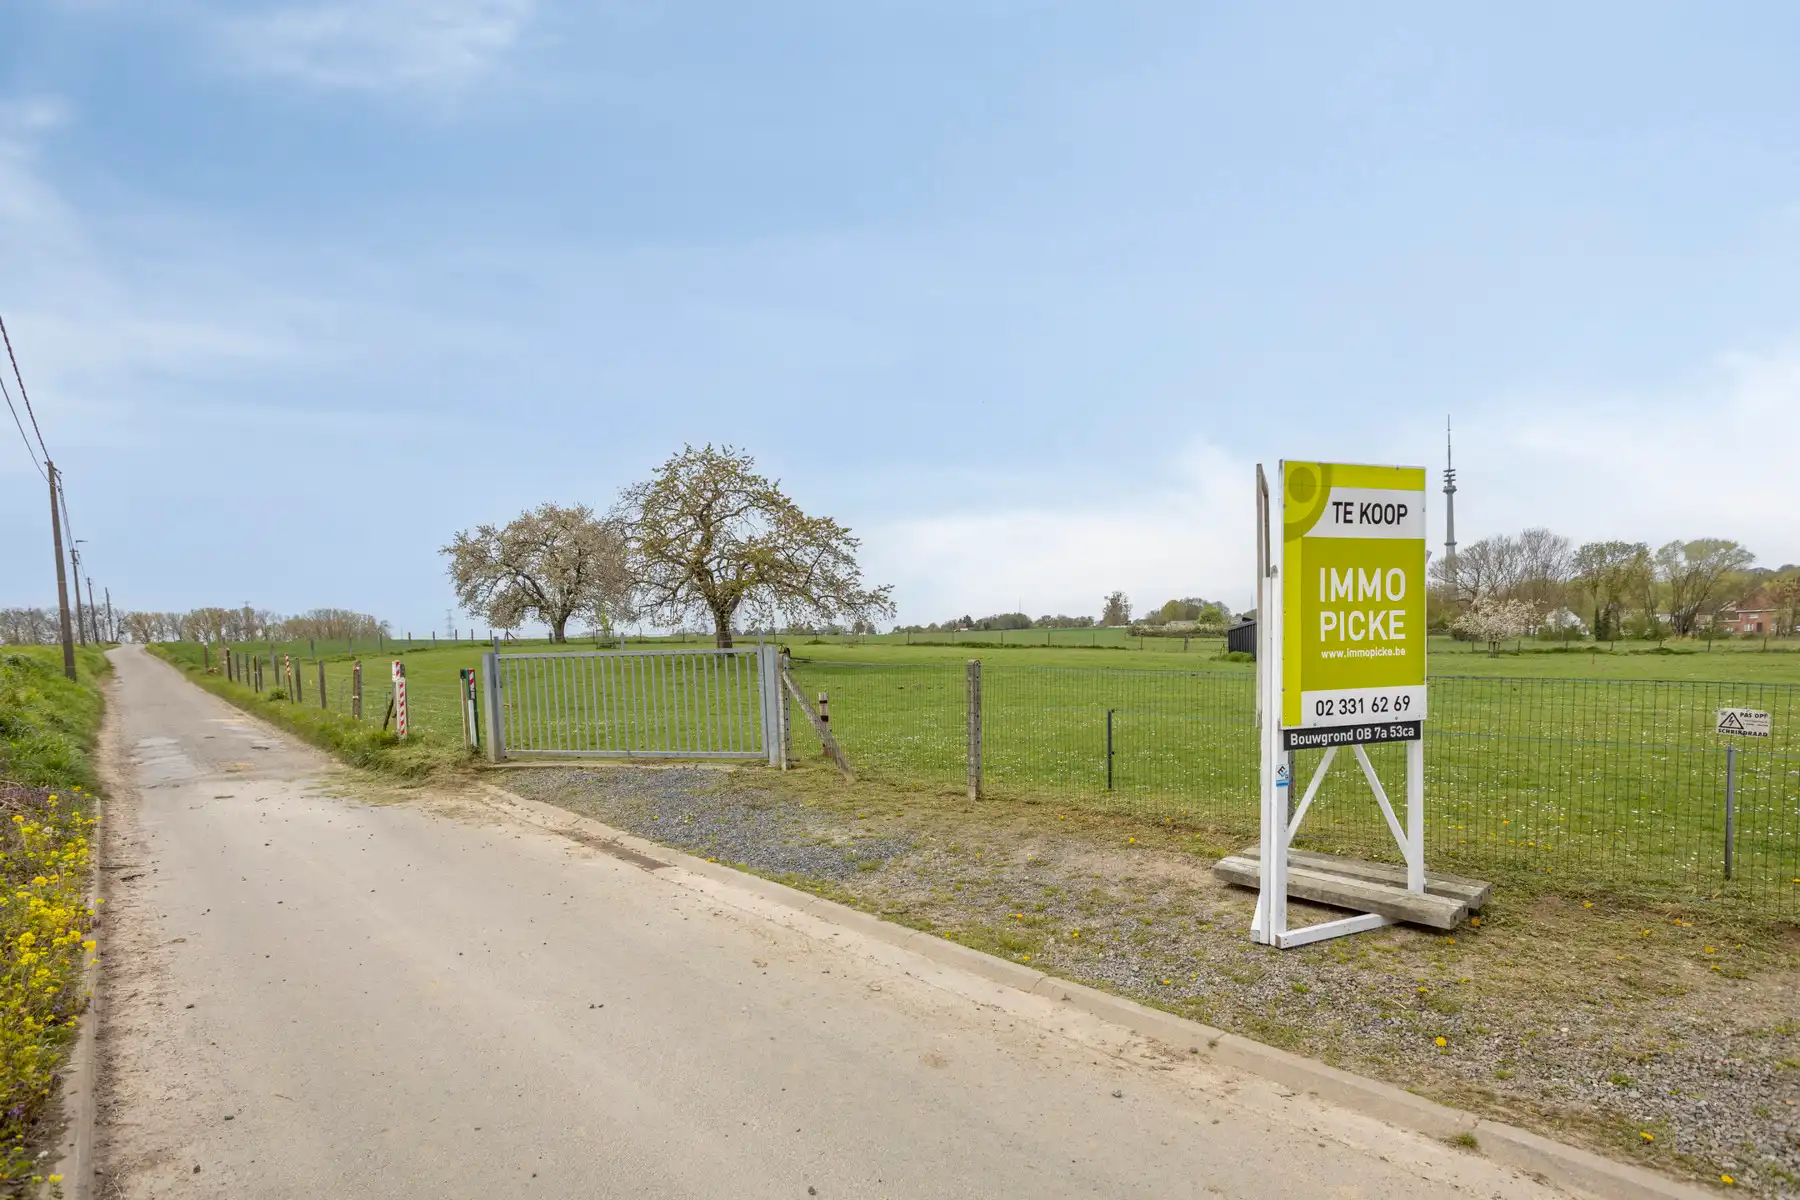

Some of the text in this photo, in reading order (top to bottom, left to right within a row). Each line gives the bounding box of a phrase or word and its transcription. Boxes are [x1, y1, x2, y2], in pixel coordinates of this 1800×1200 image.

[1332, 501, 1408, 525] TE KOOP
[1319, 567, 1406, 602] IMMO
[1320, 609, 1406, 642] PICKE
[1321, 647, 1406, 659] www.immopicke.be
[1315, 695, 1411, 716] 02 331 62 69
[1290, 726, 1415, 746] Bouwgrond OB 7a 53ca
[1718, 728, 1768, 737] SCHRIKDRAAD
